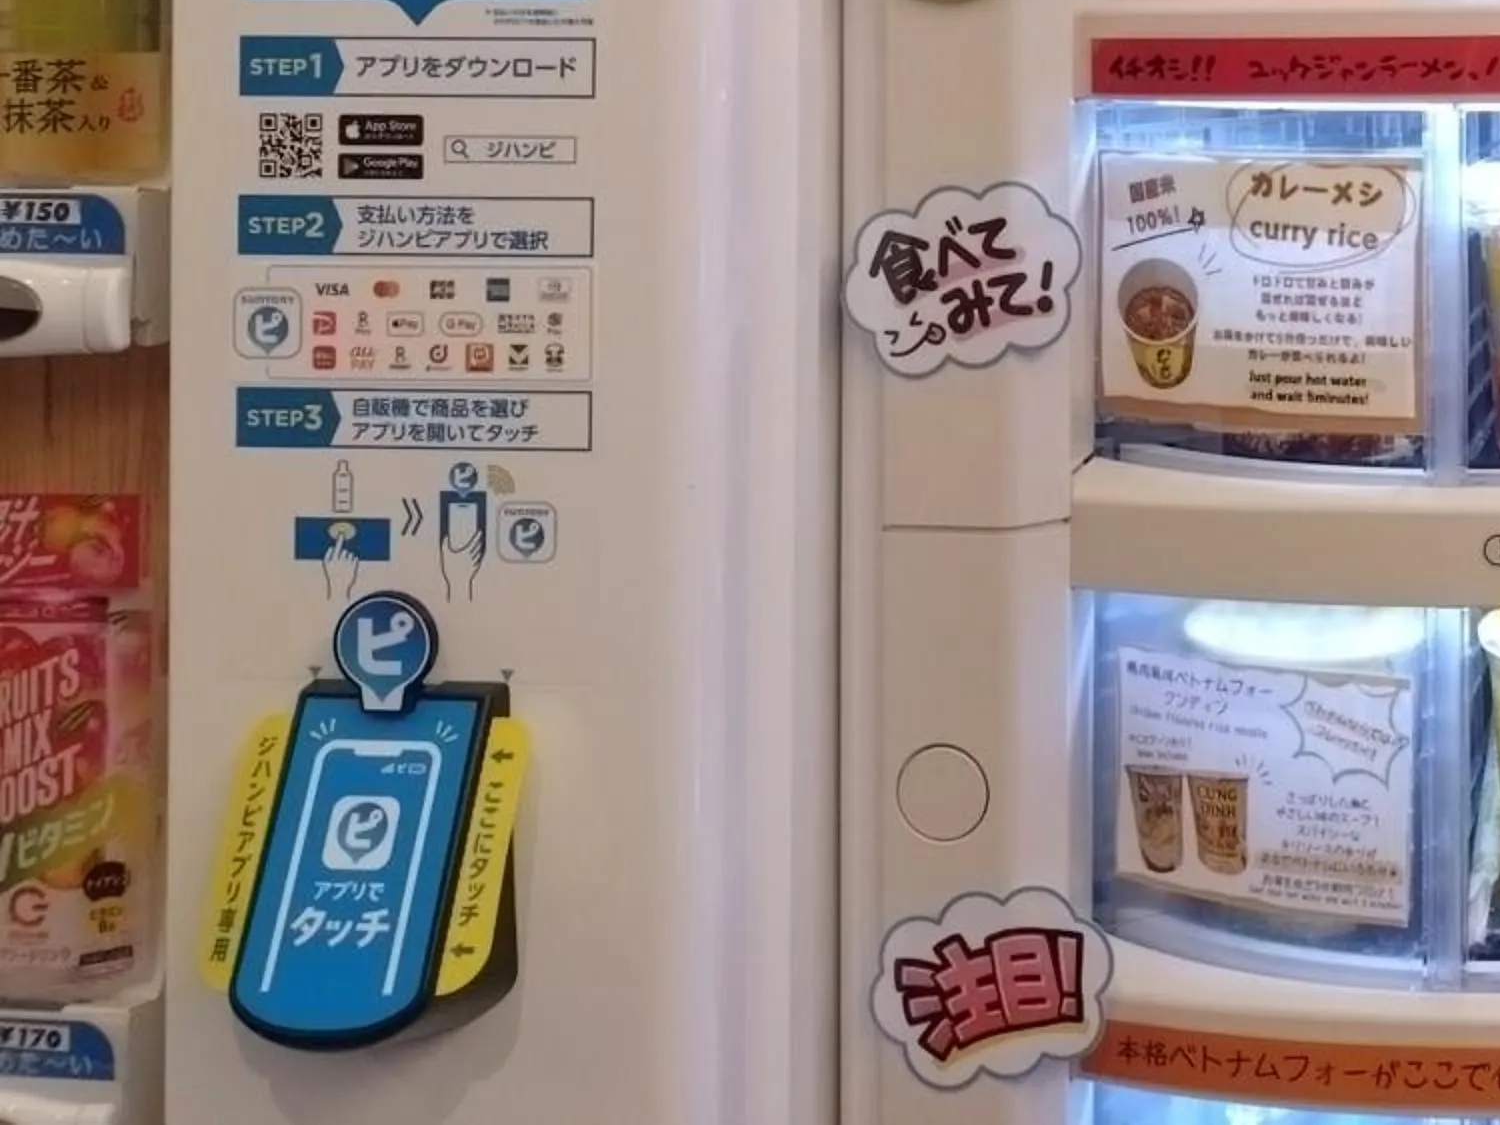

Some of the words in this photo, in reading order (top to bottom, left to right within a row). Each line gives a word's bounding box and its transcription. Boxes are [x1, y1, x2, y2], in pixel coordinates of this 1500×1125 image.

[0, 58, 110, 94] 番茶&
[249, 54, 323, 78] STEP1
[356, 57, 578, 79] アプリをダウンロード
[4, 98, 111, 134] 抹茶入り
[1251, 172, 1384, 208] カレーメシ
[2, 201, 70, 222] ¥150
[357, 204, 476, 226] 支払い方法を
[248, 212, 325, 239] STEP2
[1250, 220, 1319, 251] curry
[1327, 222, 1380, 250] rice
[357, 230, 549, 251] ジハンピアプリで選択
[869, 215, 1017, 305] 食べて
[315, 282, 350, 296] VISA
[940, 260, 1055, 335] みて!
[1249, 370, 1272, 384] Just
[1305, 373, 1327, 386] hot
[1330, 375, 1367, 388] water
[352, 397, 530, 419] 自販機で商品を選び
[1251, 389, 1273, 402] and
[247, 404, 323, 431] STEP3
[352, 422, 541, 445] アプリを開いてタッチ
[356, 612, 415, 675] ピ
[458, 781, 505, 927] ここにタッチ
[312, 881, 385, 902] アプリで
[289, 906, 392, 948] タッチ
[894, 927, 1085, 1062] 注目!
